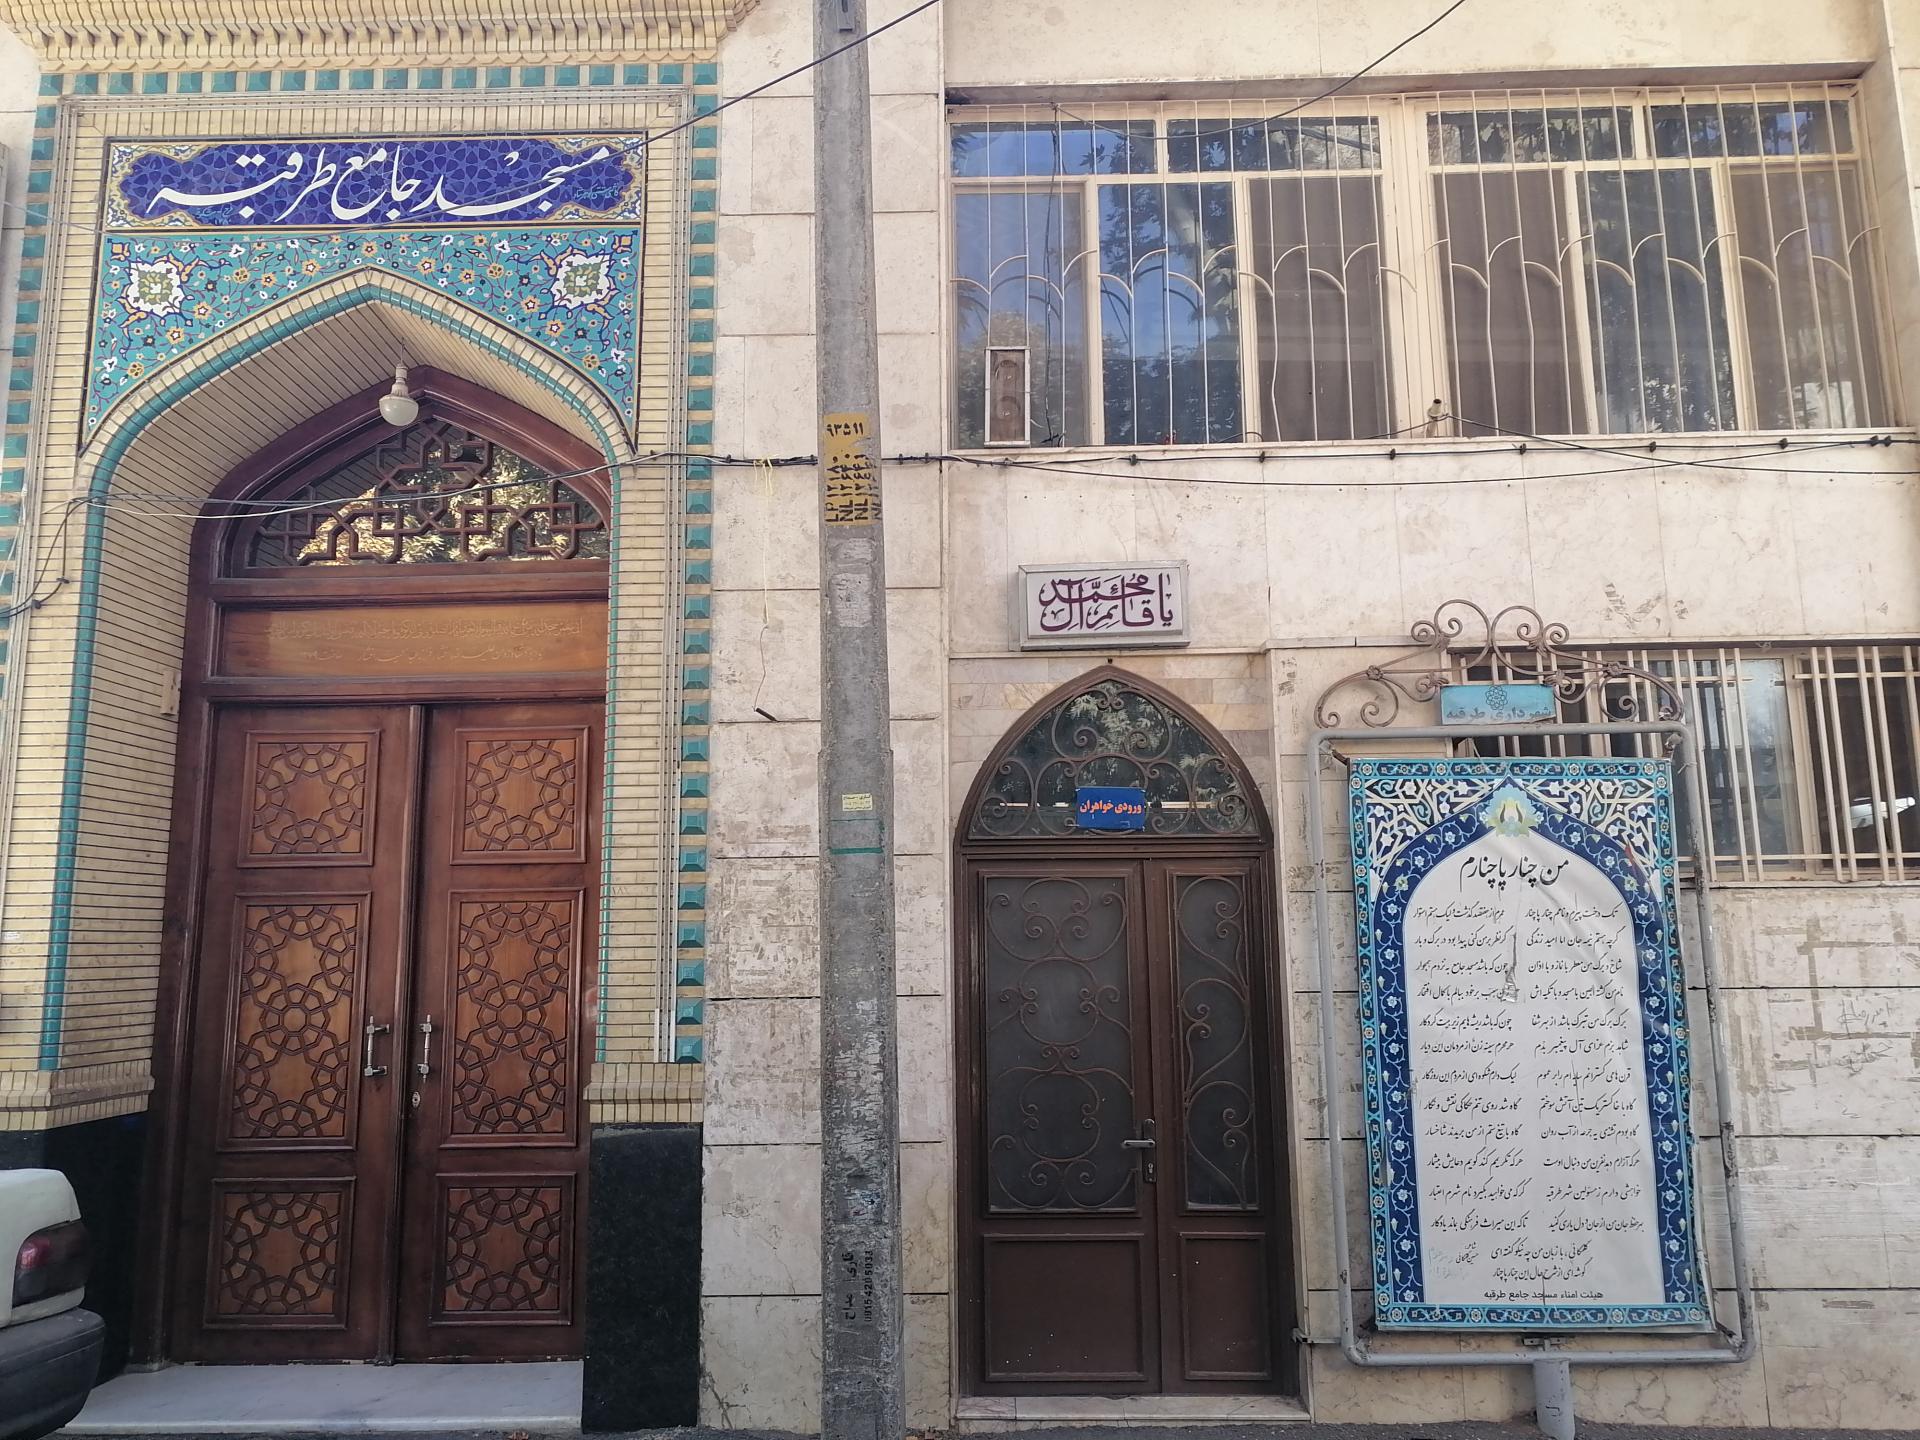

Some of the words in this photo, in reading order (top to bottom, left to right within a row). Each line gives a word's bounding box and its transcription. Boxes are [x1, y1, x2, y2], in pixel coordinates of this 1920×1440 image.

[146, 147, 337, 222] طرقبه
[331, 145, 422, 220] جامع
[410, 147, 609, 216] مسجد
[825, 502, 839, 522] LP
[838, 500, 854, 522] NL
[854, 498, 869, 520] NL
[1079, 799, 1114, 814] خواهران
[1114, 802, 1142, 814] ورودی
[1508, 856, 1538, 888] چنار
[1539, 859, 1569, 886] من
[1541, 908, 1552, 920] چنار
[1451, 961, 1465, 975] جامع
[1528, 960, 1544, 973] اذان
[1580, 962, 1593, 973] من
[1561, 987, 1575, 1000] مسجد
[1588, 1018, 1600, 1029] من
[1465, 1127, 1477, 1138] من
[1580, 1158, 1592, 1169] من
[1531, 1248, 1543, 1259] من
[1484, 1289, 1507, 1301] طرقبه
[1509, 1289, 1529, 1302] جامع
[1531, 1291, 1558, 1300] مسجد
